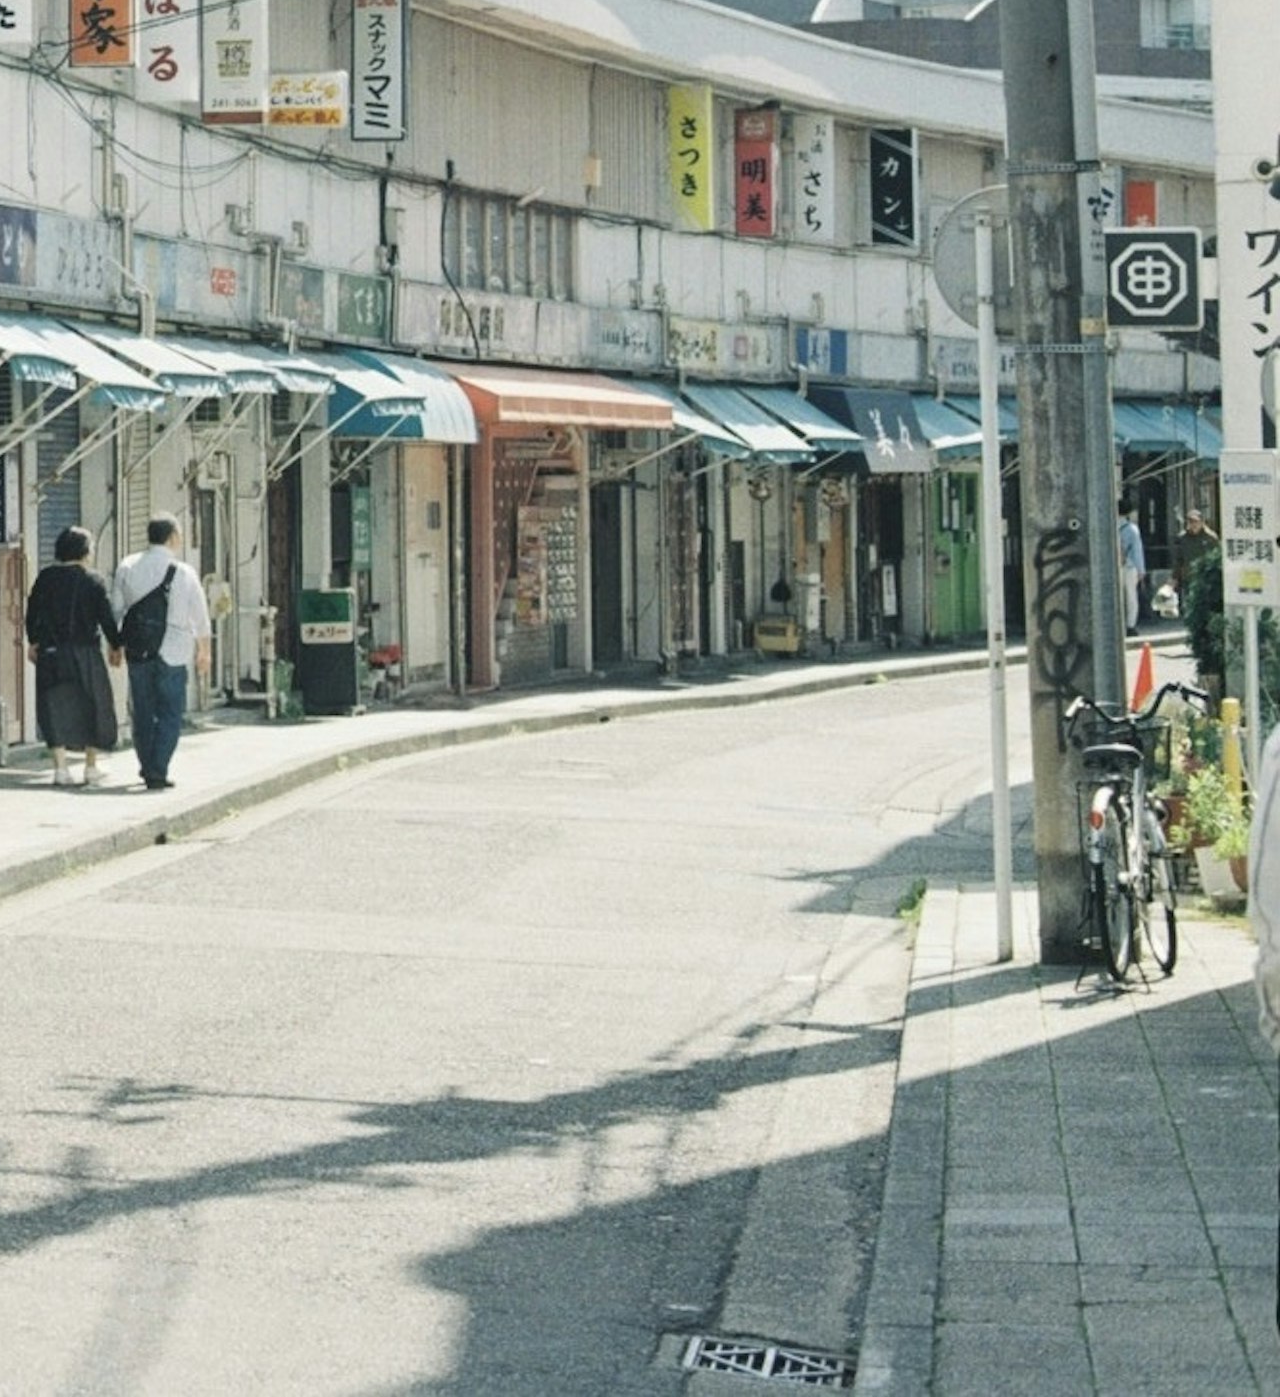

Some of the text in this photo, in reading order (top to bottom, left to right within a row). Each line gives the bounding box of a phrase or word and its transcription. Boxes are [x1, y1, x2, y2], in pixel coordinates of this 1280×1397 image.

[368, 13, 387, 72] スナック
[363, 75, 391, 129] マミ
[678, 116, 700, 197] さつき
[741, 157, 767, 221] 明美
[802, 170, 823, 234] さち
